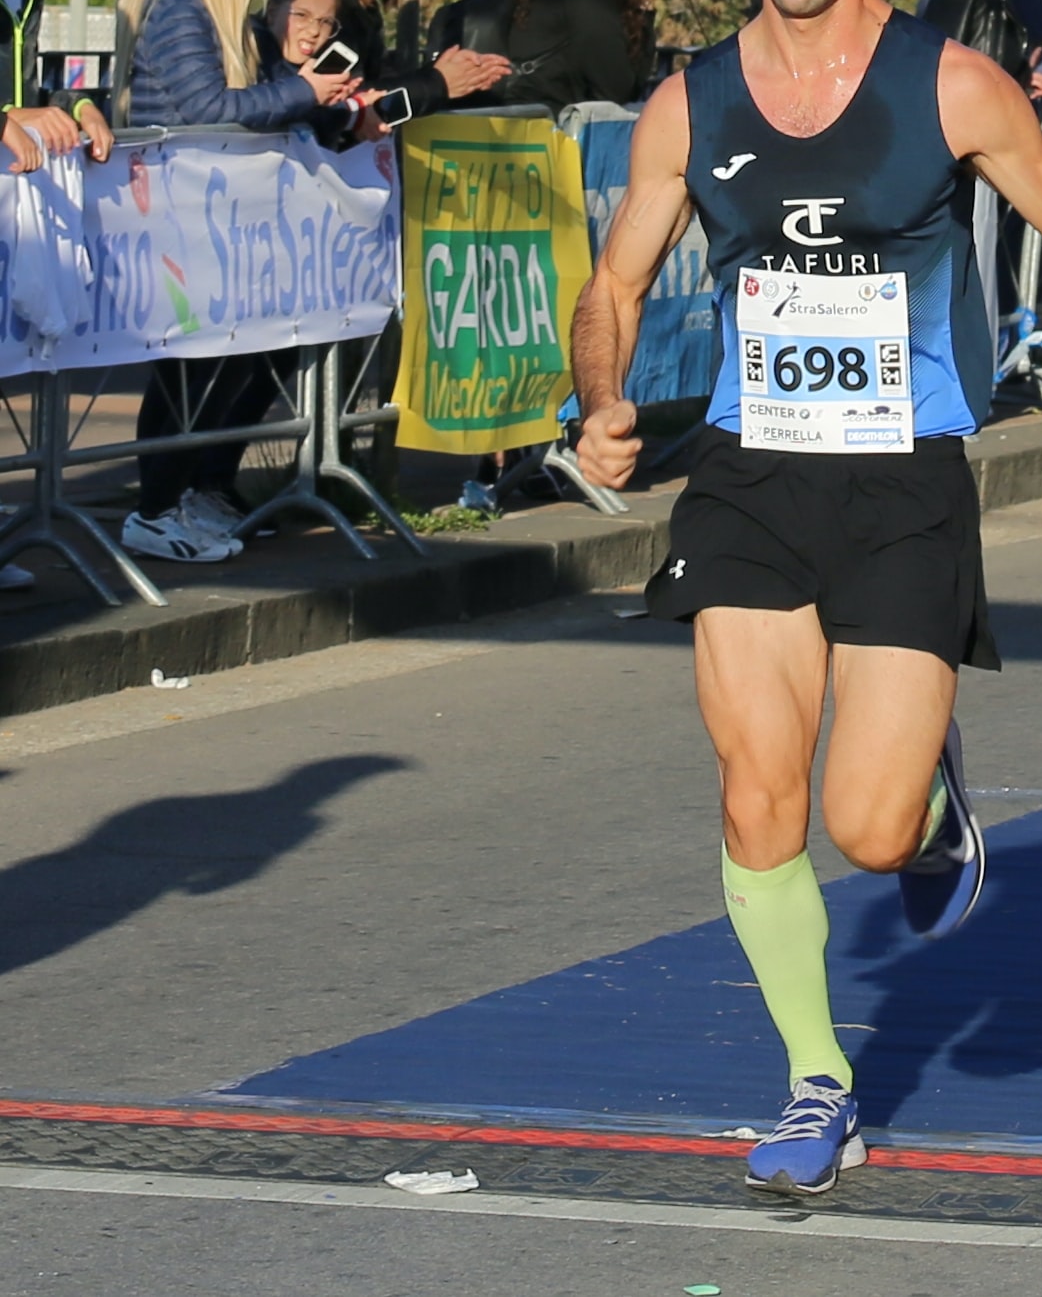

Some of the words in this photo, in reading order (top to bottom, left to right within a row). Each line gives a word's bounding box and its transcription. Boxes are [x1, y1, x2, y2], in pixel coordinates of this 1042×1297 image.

[762, 253, 880, 274] TAFURI
[425, 243, 557, 349] GARDA
[788, 302, 868, 316] StraSalerno
[773, 345, 869, 393] 698
[427, 354, 516, 419] Medical
[748, 404, 796, 419] CENTER
[763, 427, 823, 441] PERRELLA
